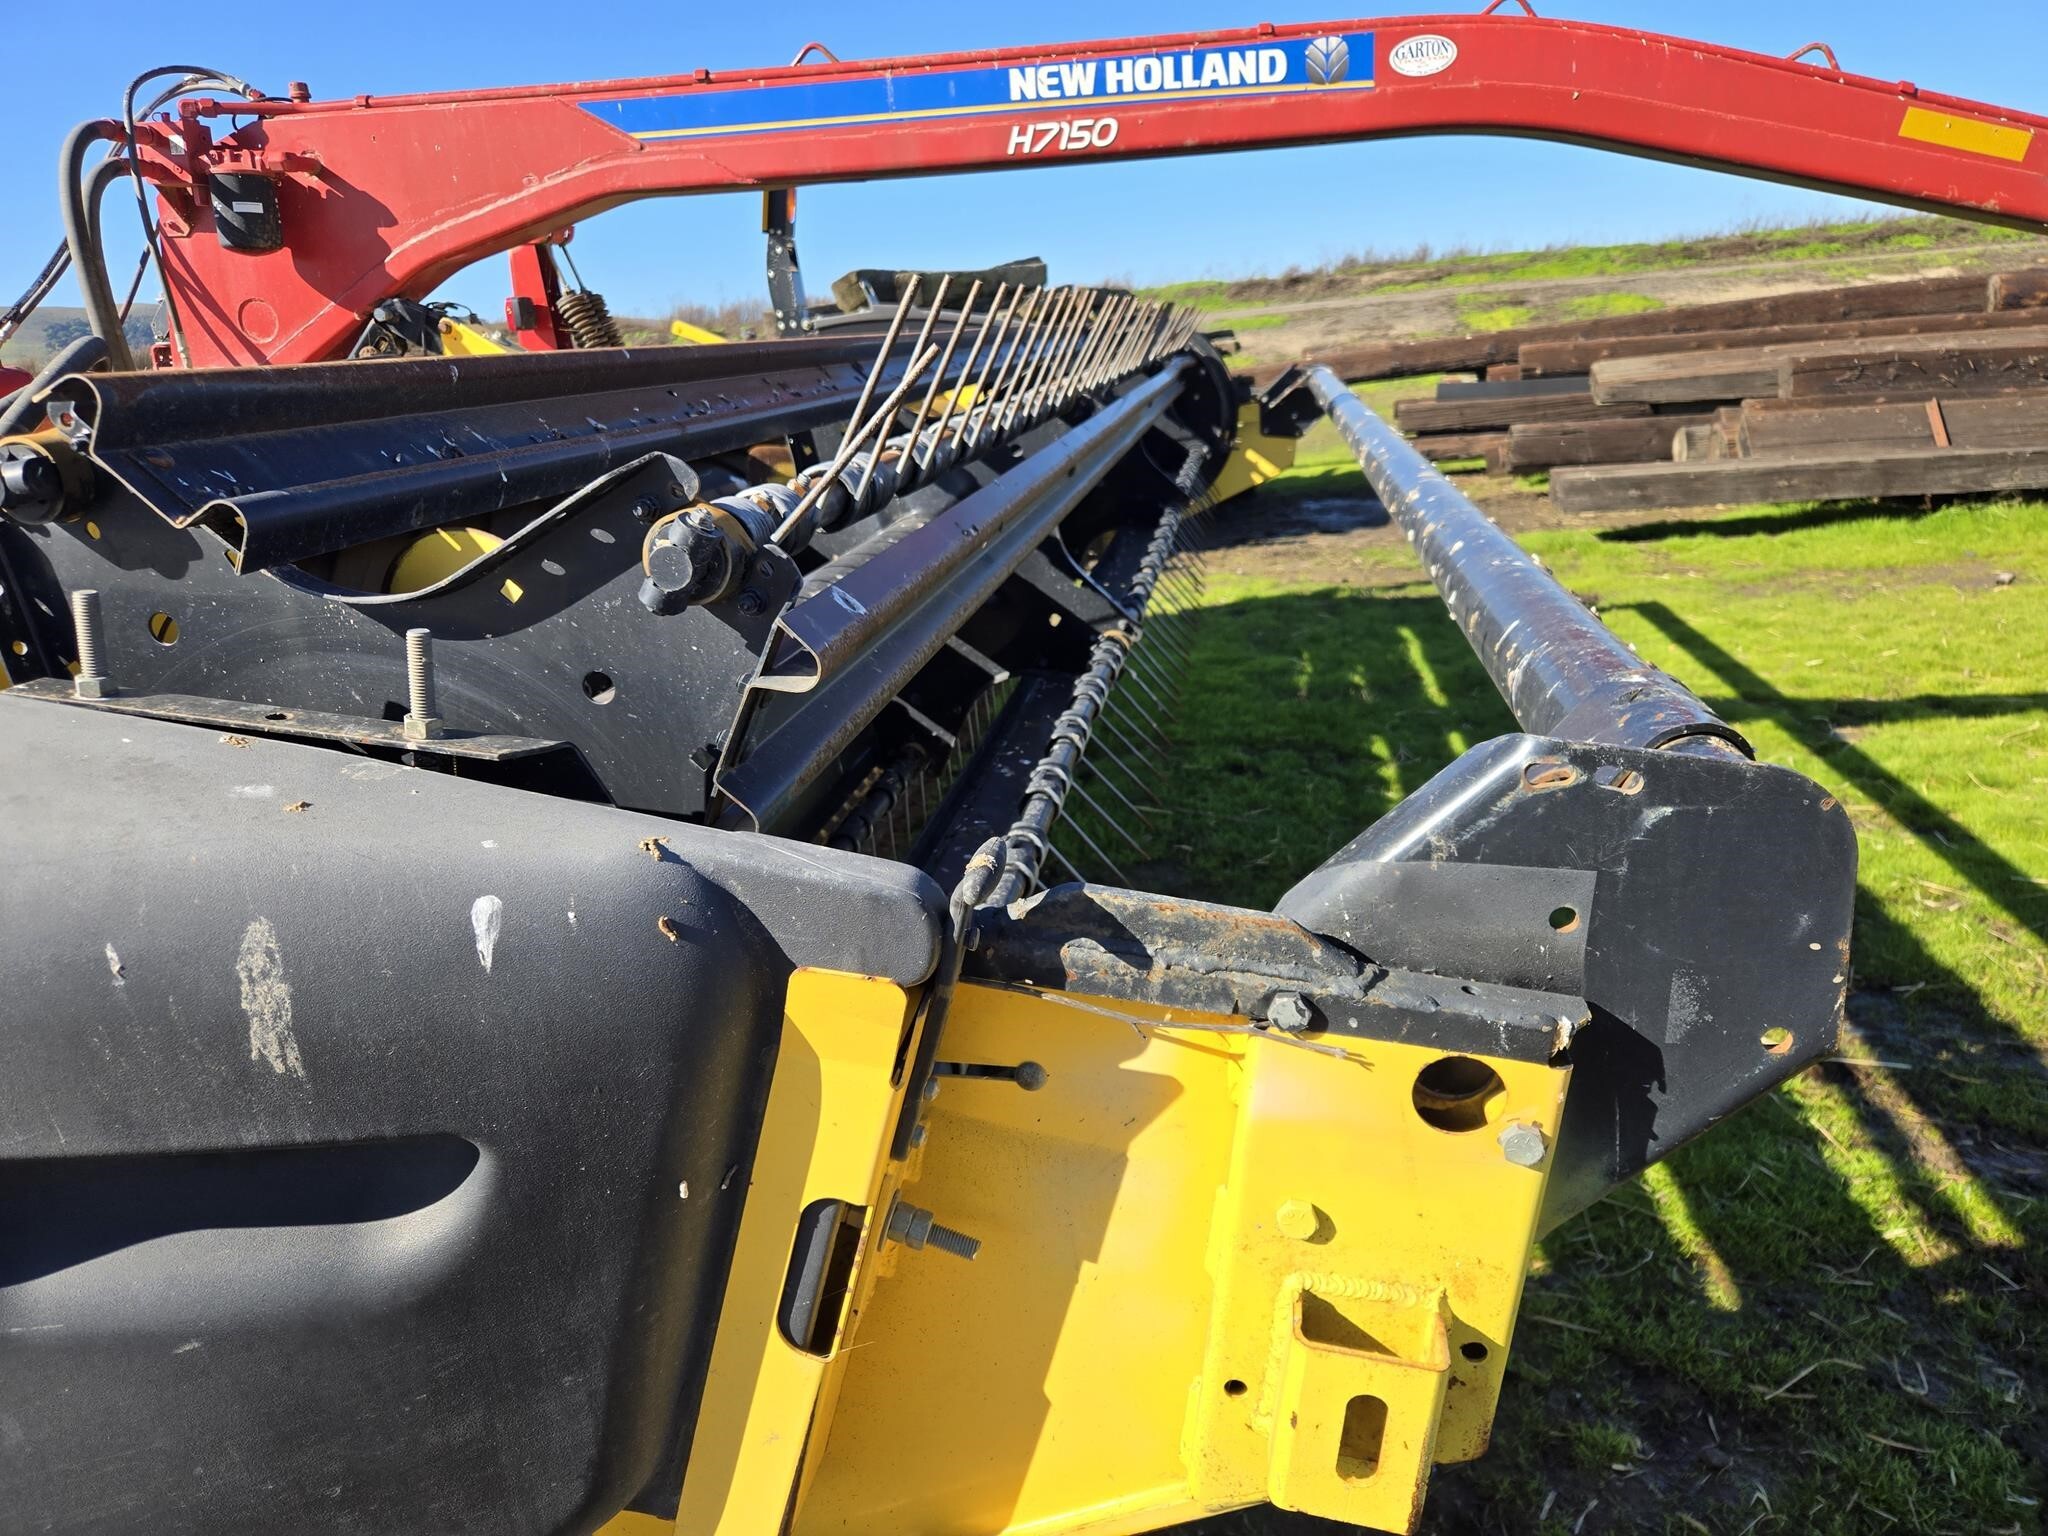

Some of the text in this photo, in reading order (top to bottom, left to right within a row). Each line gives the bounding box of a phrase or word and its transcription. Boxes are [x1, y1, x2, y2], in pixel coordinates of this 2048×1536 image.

[1395, 40, 1449, 60] GARTON
[1008, 49, 1287, 101] NEW HOLLAND
[1007, 117, 1118, 155] H7150
